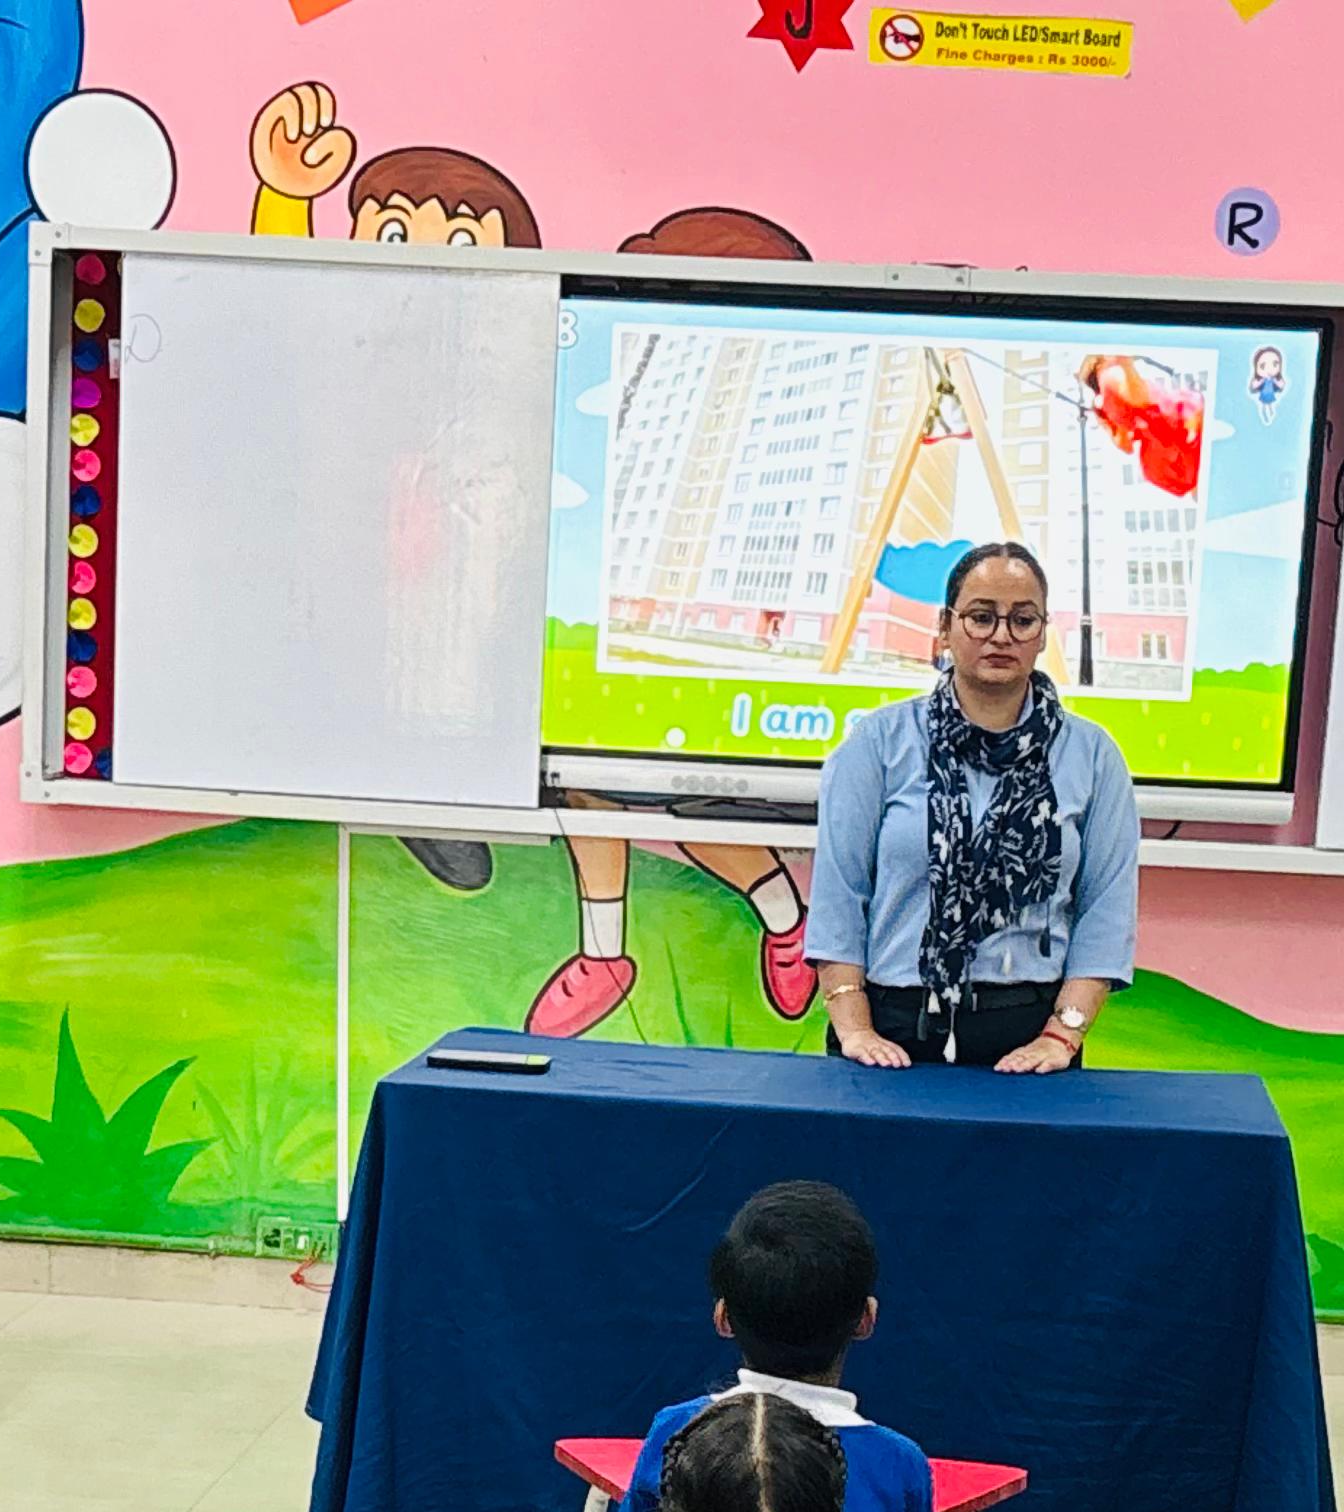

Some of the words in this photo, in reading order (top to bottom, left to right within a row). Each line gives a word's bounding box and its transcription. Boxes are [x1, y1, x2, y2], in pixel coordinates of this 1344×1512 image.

[935, 21, 967, 40] Don't
[972, 22, 1009, 41] Touch
[1083, 28, 1121, 48] Board
[936, 47, 968, 60] Fine
[972, 49, 1034, 65] Charges
[1048, 53, 1066, 65] Rs
[1226, 201, 1264, 249] R
[763, 707, 832, 738] am
